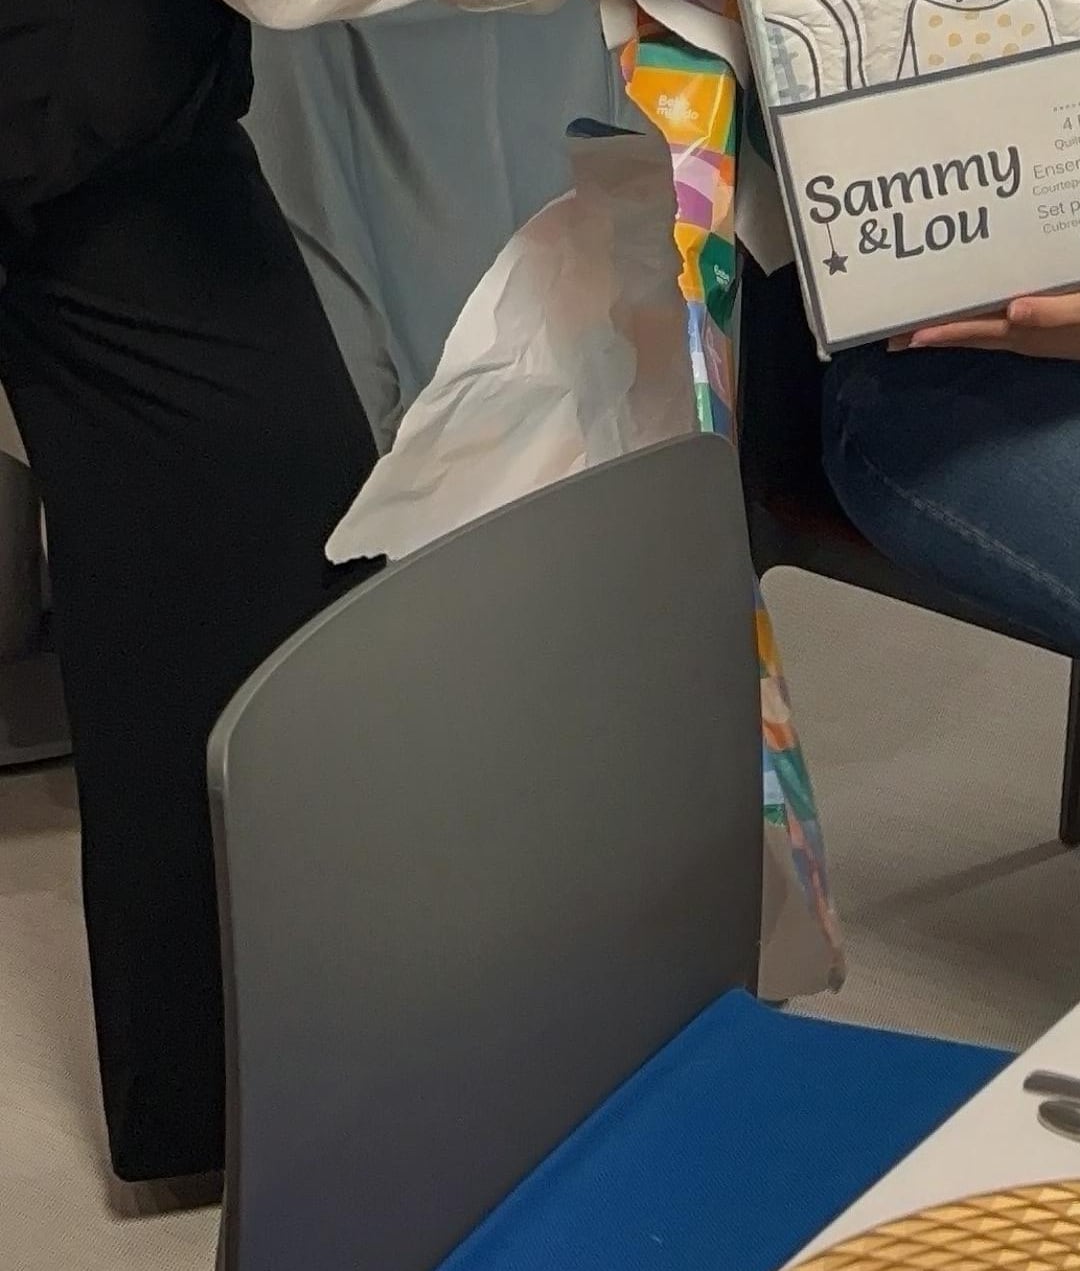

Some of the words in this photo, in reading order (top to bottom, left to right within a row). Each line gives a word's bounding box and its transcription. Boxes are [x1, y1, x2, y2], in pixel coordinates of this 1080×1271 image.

[1062, 116, 1073, 130] 4
[805, 145, 1021, 224] Sammy
[1037, 201, 1066, 220] Set
[858, 206, 990, 259] &Lou
